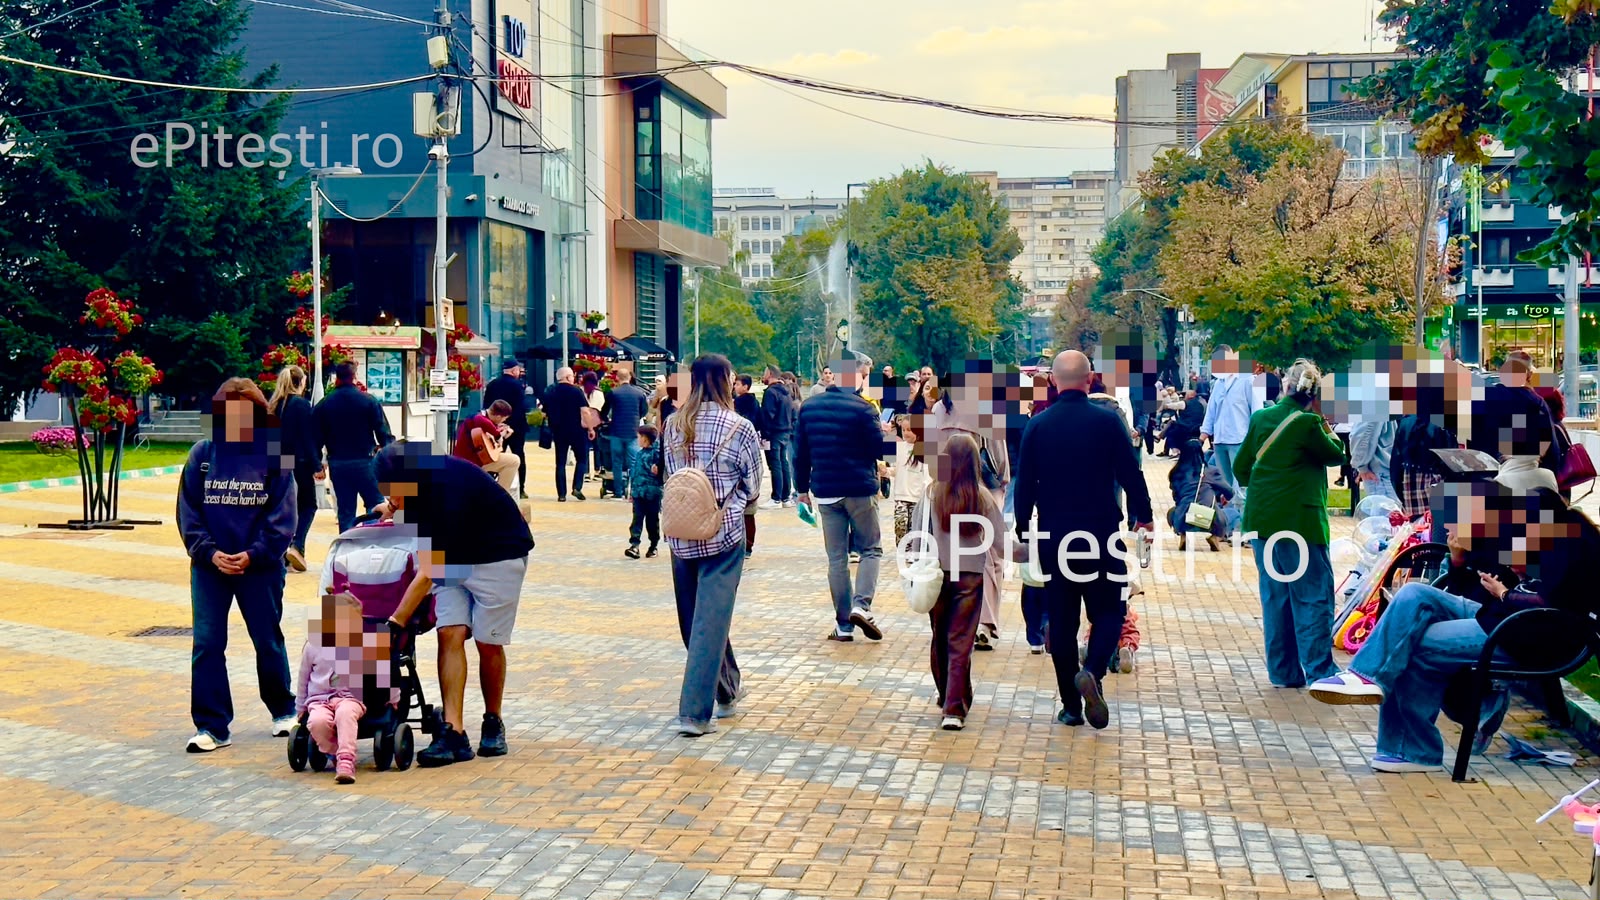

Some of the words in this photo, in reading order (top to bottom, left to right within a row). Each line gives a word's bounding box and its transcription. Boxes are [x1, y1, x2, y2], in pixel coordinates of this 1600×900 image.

[503, 196, 526, 213] STARBUCKS
[1524, 305, 1550, 315] froo
[212, 480, 228, 489] trust
[229, 478, 240, 490] the
[221, 492, 238, 505] takes
[239, 493, 256, 505] hard
